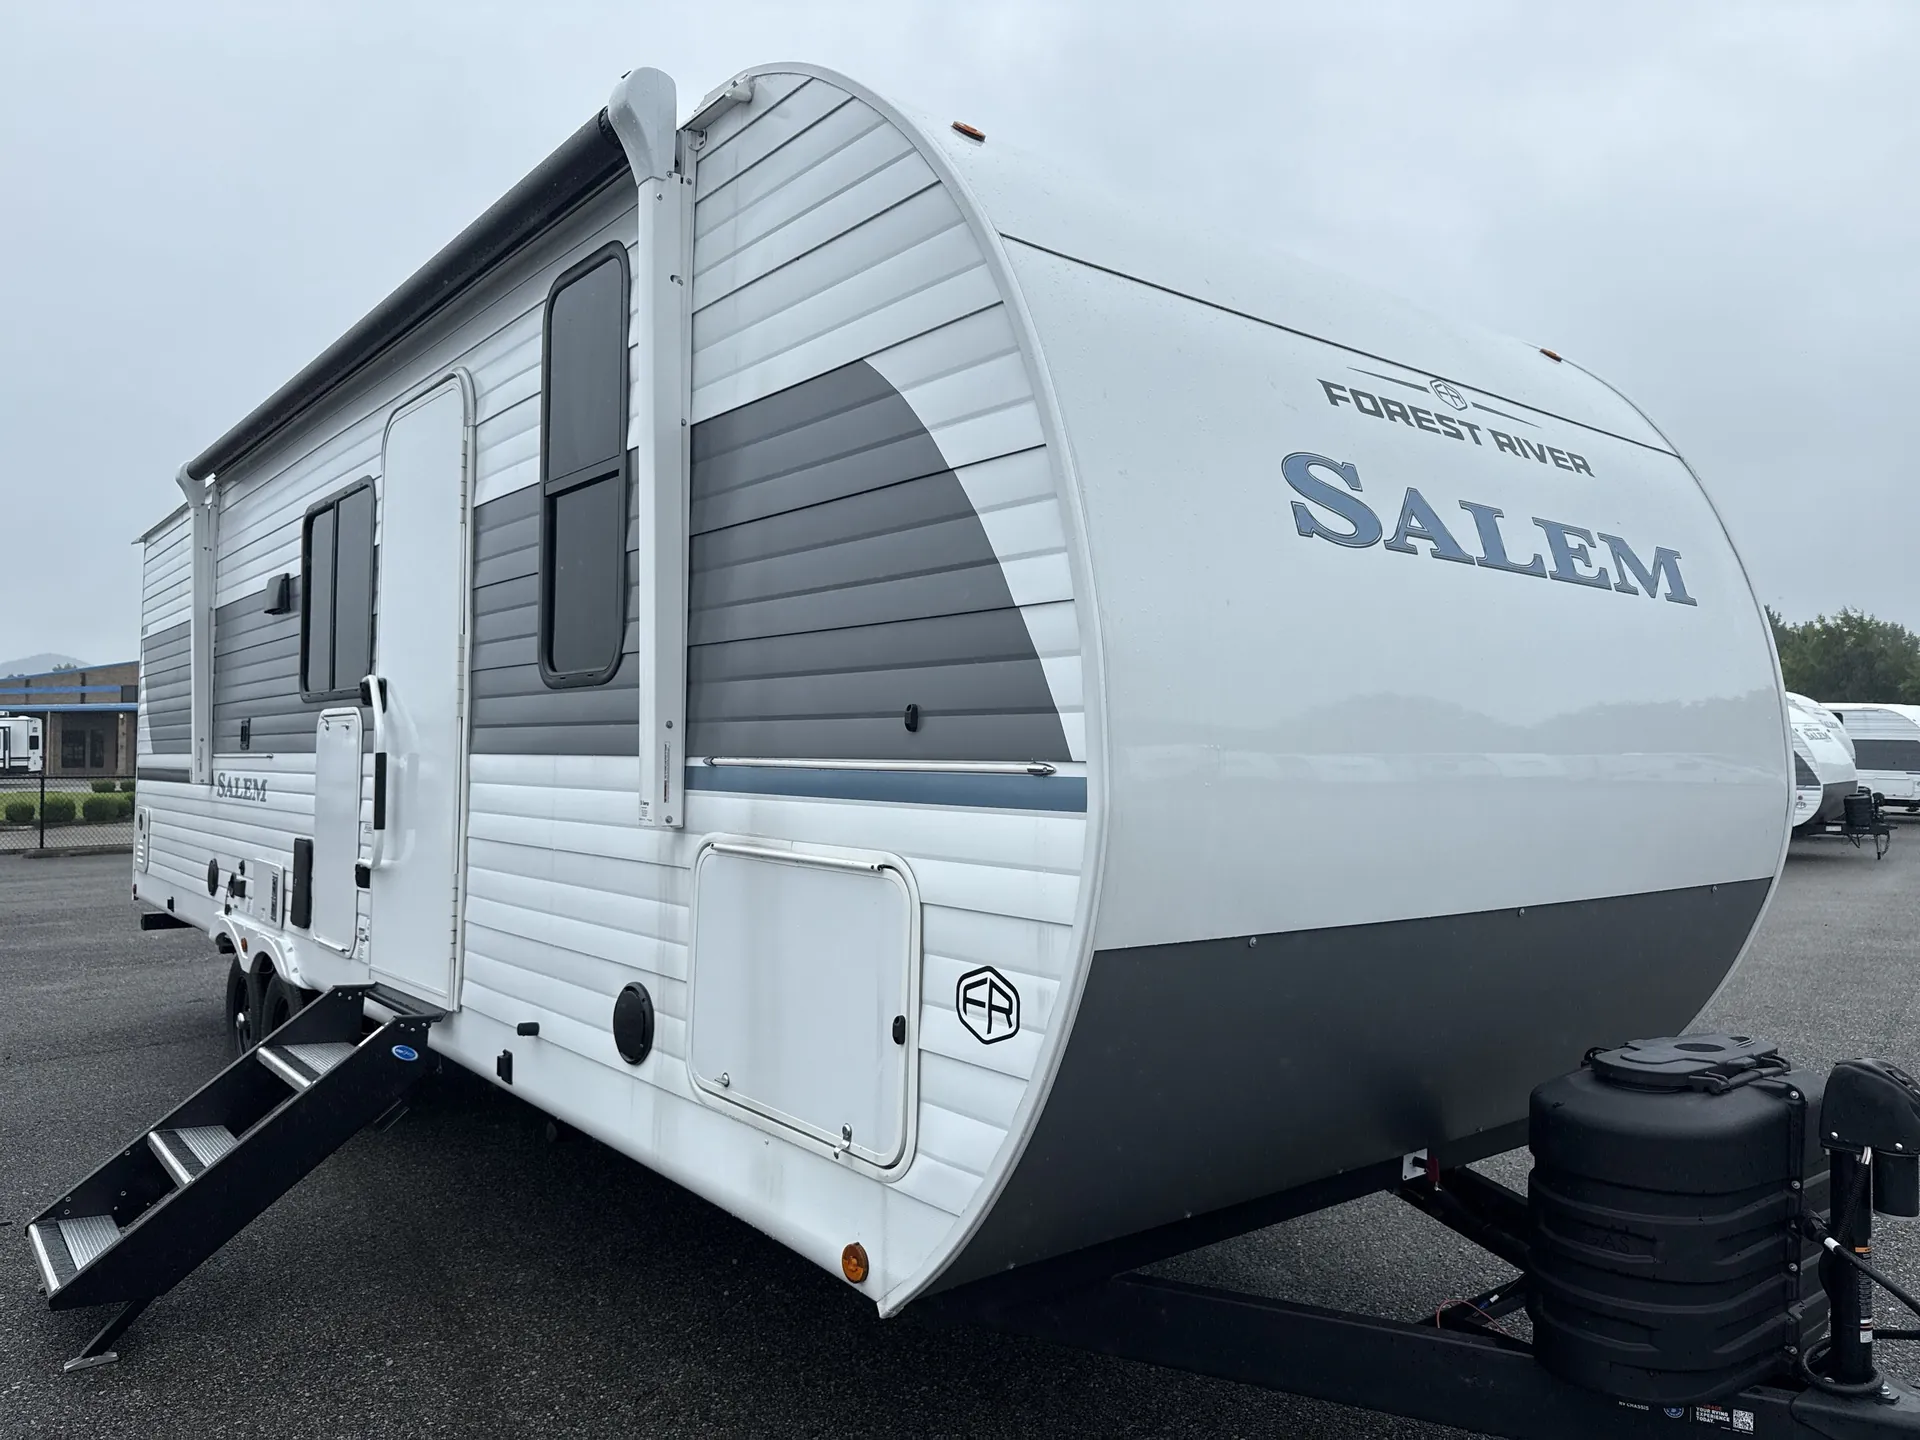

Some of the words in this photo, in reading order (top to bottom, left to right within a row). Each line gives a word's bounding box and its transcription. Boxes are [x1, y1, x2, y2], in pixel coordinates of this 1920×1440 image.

[1316, 378, 1482, 446] FOREST
[1486, 428, 1596, 478] RIVER
[1281, 451, 1698, 607] SALEM
[217, 772, 268, 802] SALEM
[1626, 1403, 1650, 1411] CHASSIS
[1696, 1411, 1730, 1422] EXPERIENCE
